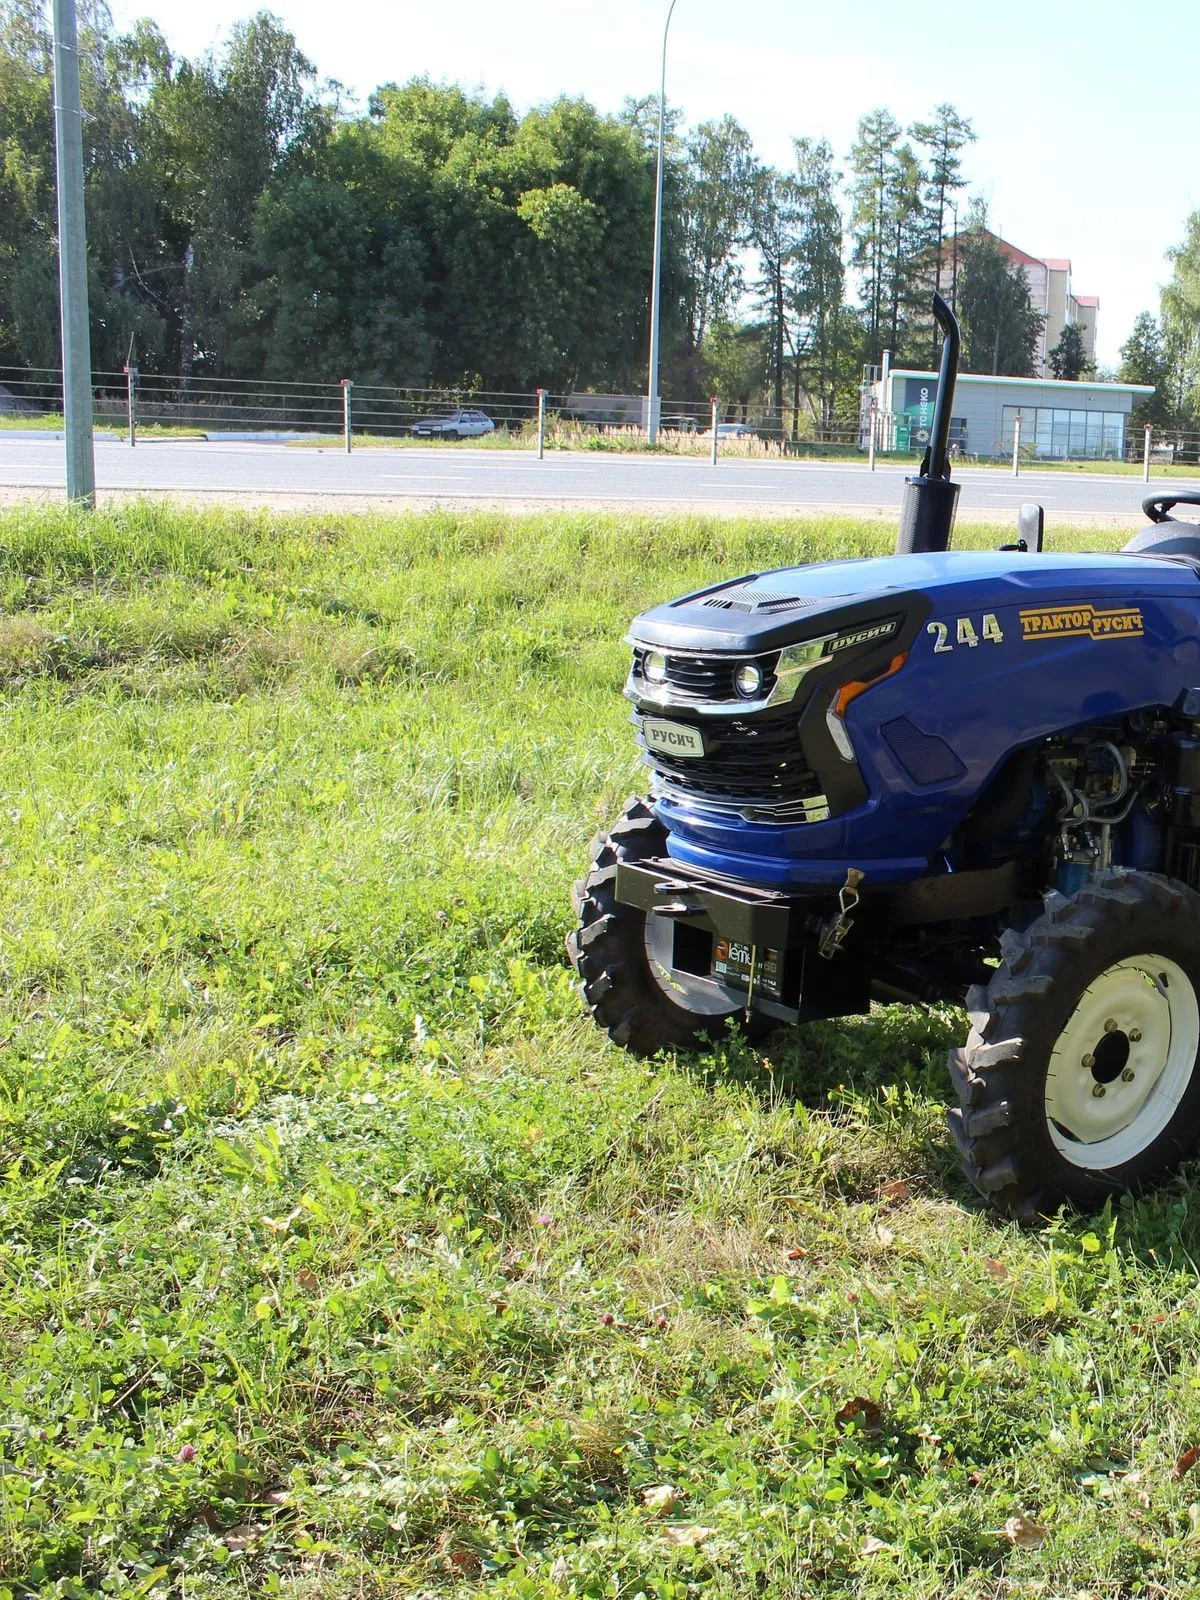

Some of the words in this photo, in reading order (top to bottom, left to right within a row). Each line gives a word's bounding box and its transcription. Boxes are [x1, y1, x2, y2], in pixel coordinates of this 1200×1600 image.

[926, 613, 1004, 653] 244
[1020, 611, 1092, 633] ТРАКТОР
[1092, 614, 1144, 633] РУСИЧ
[651, 729, 696, 749] РУСИЧ
